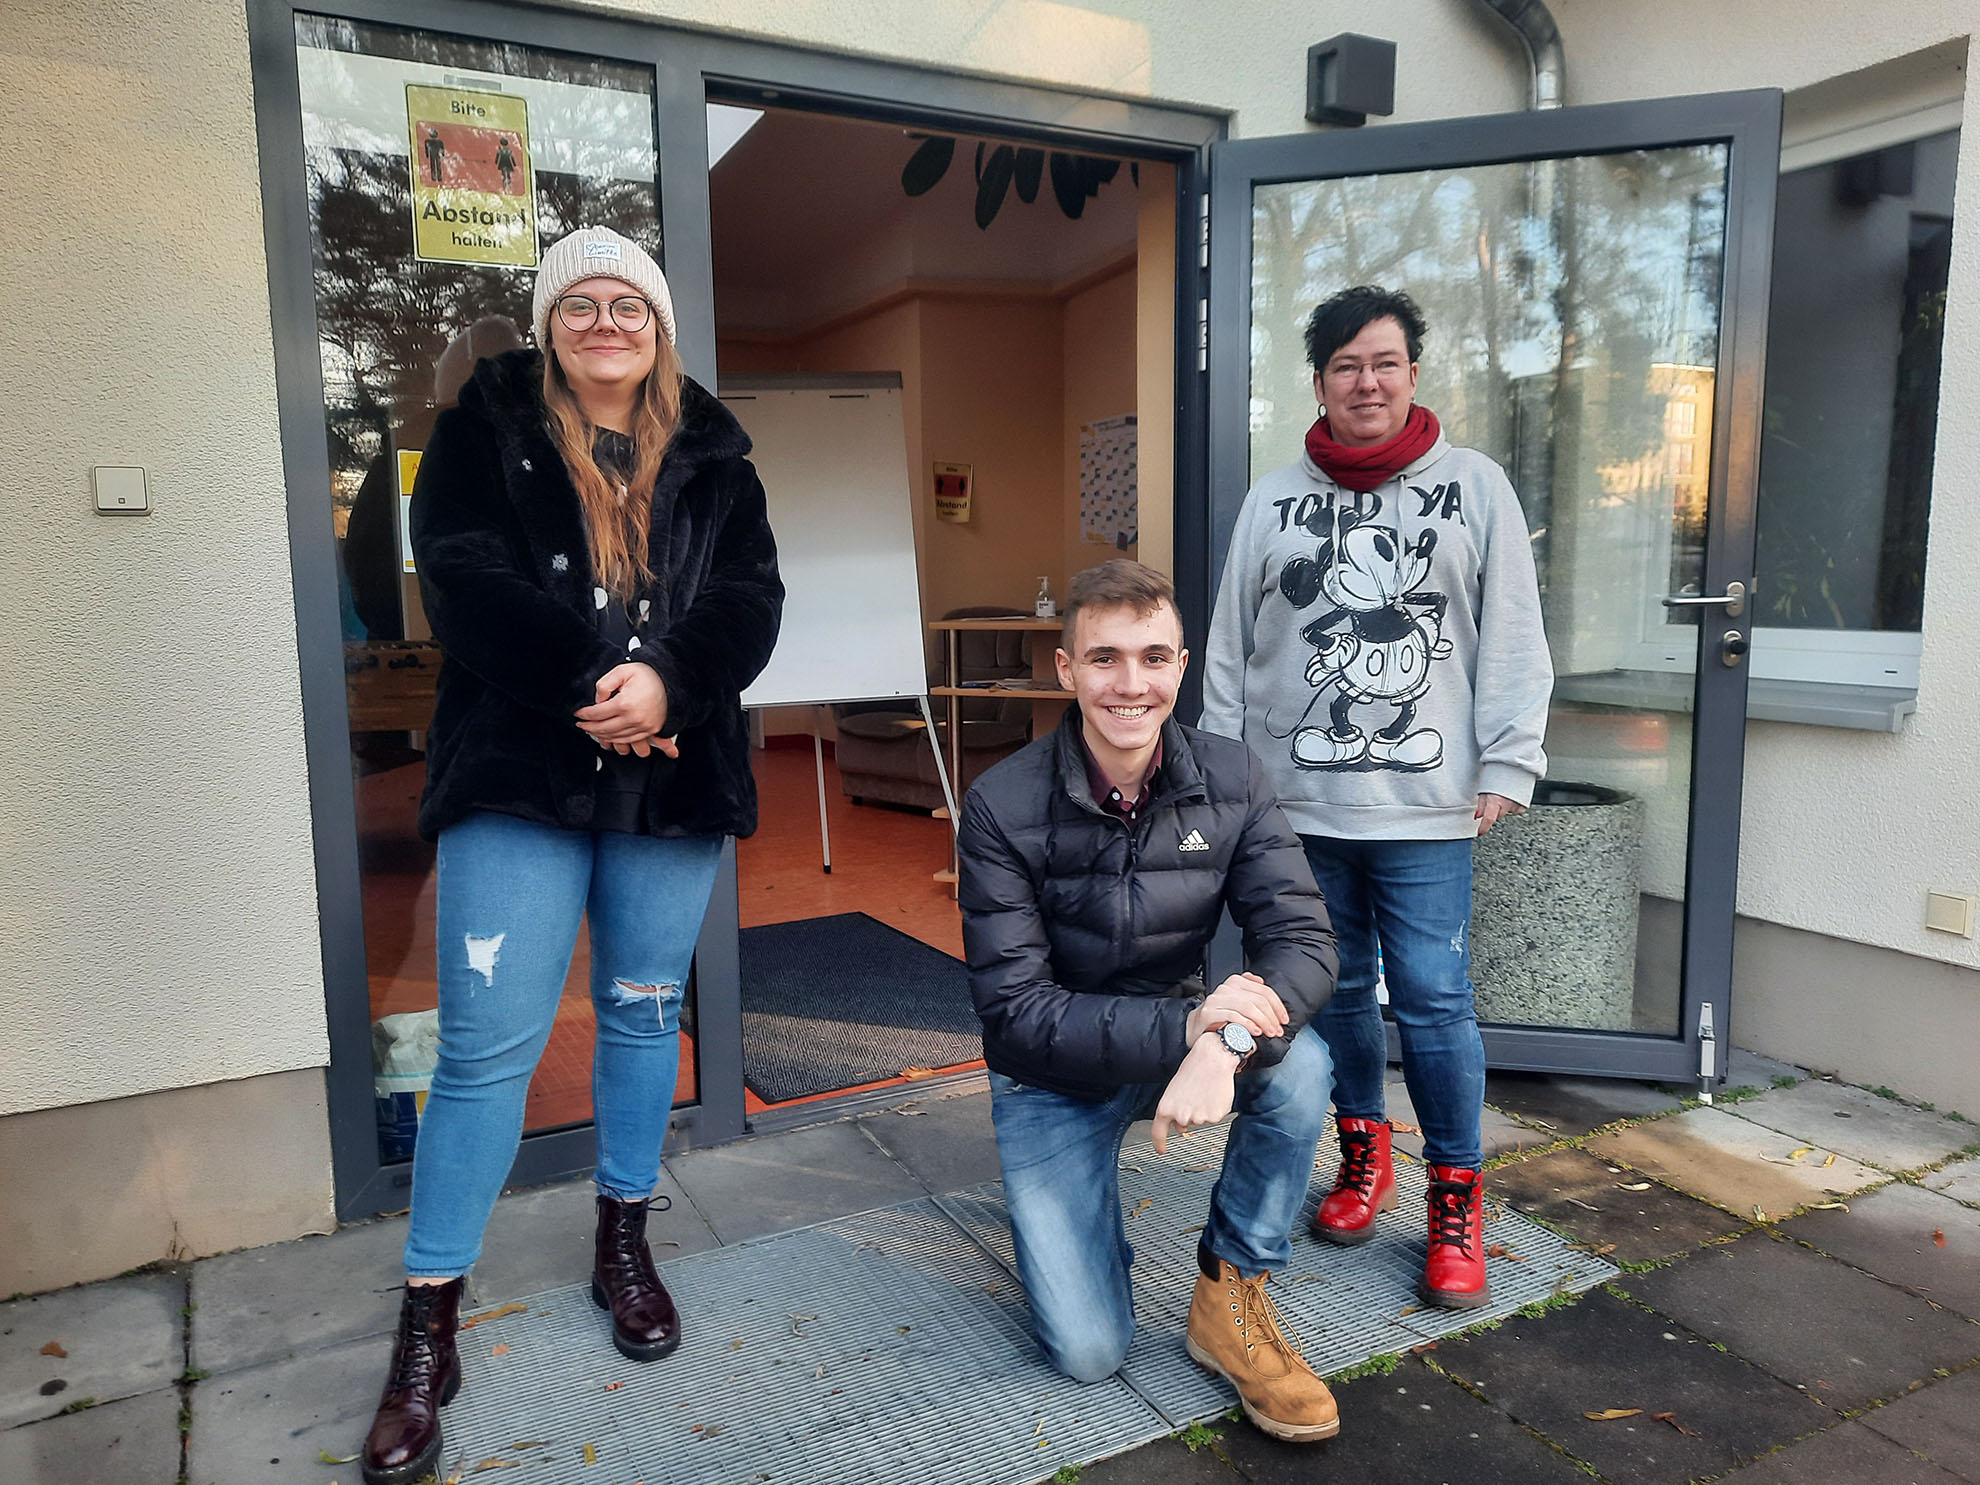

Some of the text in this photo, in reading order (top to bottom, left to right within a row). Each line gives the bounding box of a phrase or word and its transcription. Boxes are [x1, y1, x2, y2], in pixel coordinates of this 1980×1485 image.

[451, 100, 486, 117] Bitte
[451, 231, 503, 249] halten
[1407, 480, 1467, 527] YA
[1178, 842, 1210, 852] adidas
